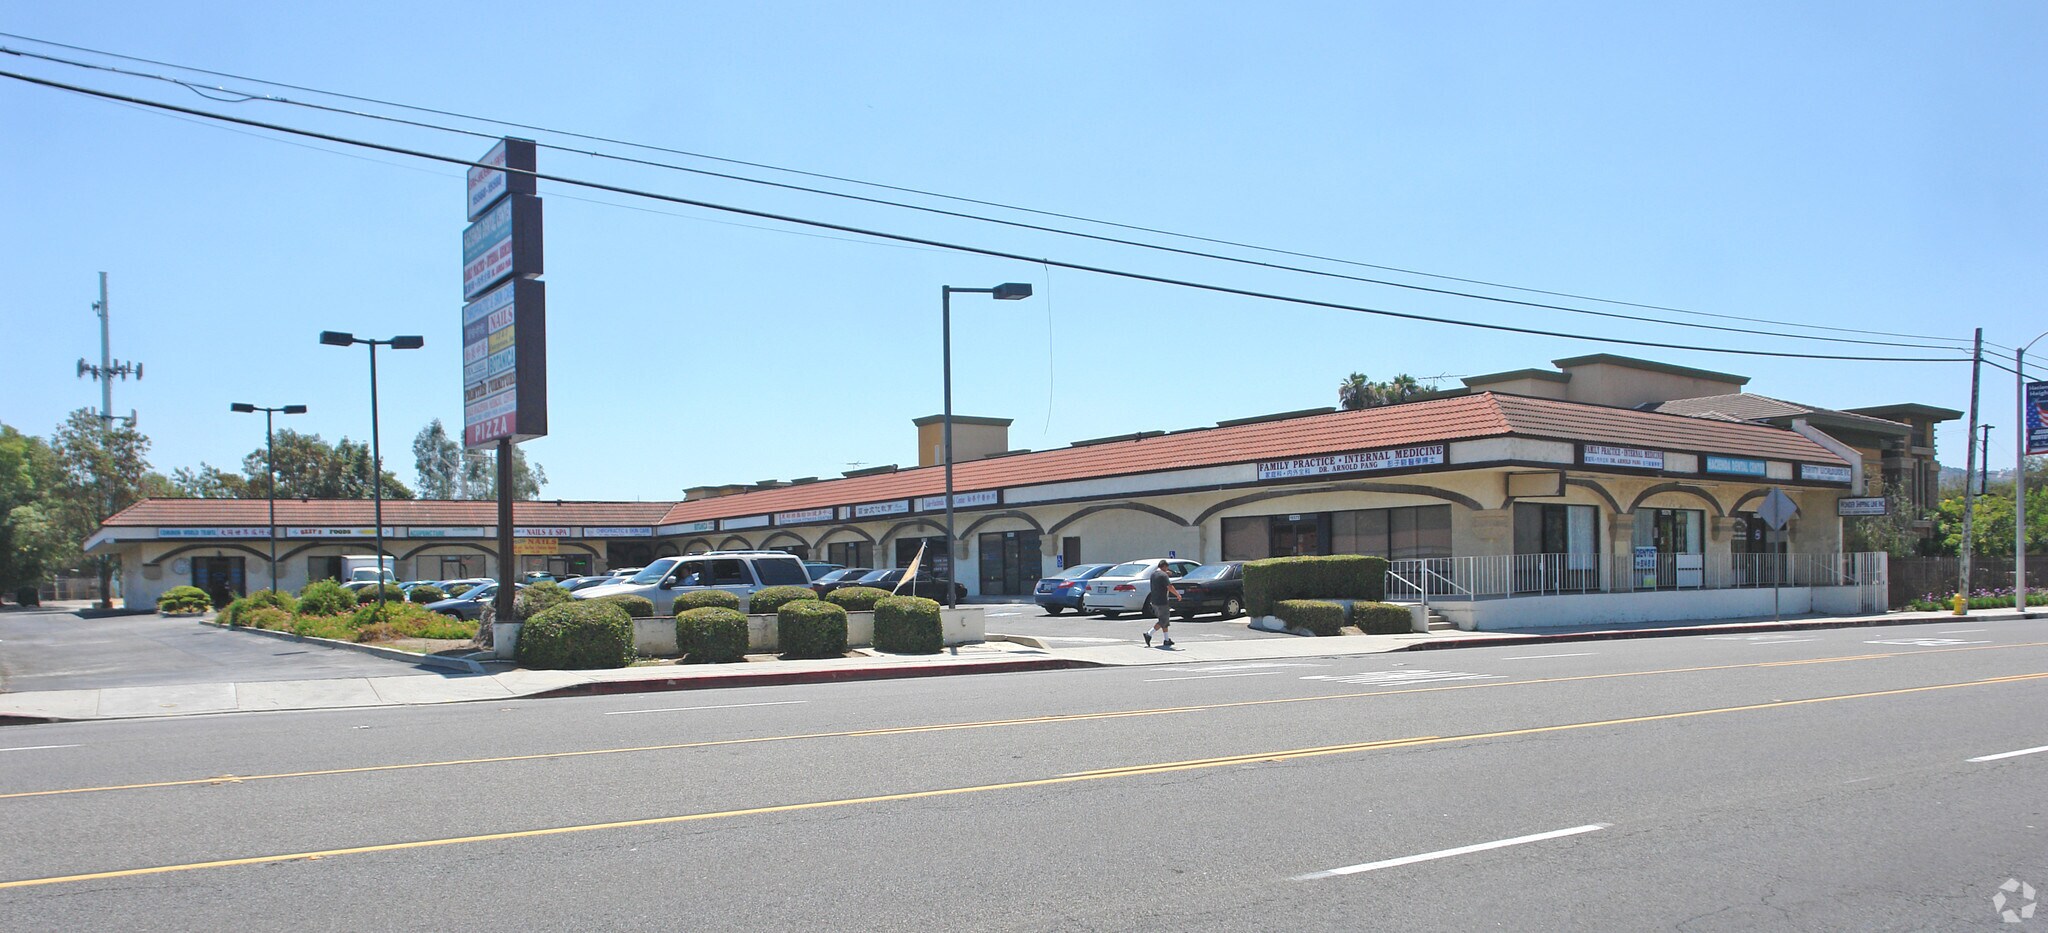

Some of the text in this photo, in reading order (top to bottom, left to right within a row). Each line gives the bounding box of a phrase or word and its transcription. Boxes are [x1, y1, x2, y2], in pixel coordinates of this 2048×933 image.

[490, 307, 513, 331] NAILS
[475, 416, 508, 442] PIZZA
[1260, 446, 1442, 472] FAMILY PRACTICE INTERNAL MEDICINE
[1585, 445, 1600, 454] FAMILY
[1601, 446, 1621, 456] PRACTICE
[1333, 463, 1358, 471] ARNOLD
[1361, 461, 1378, 469] PANG
